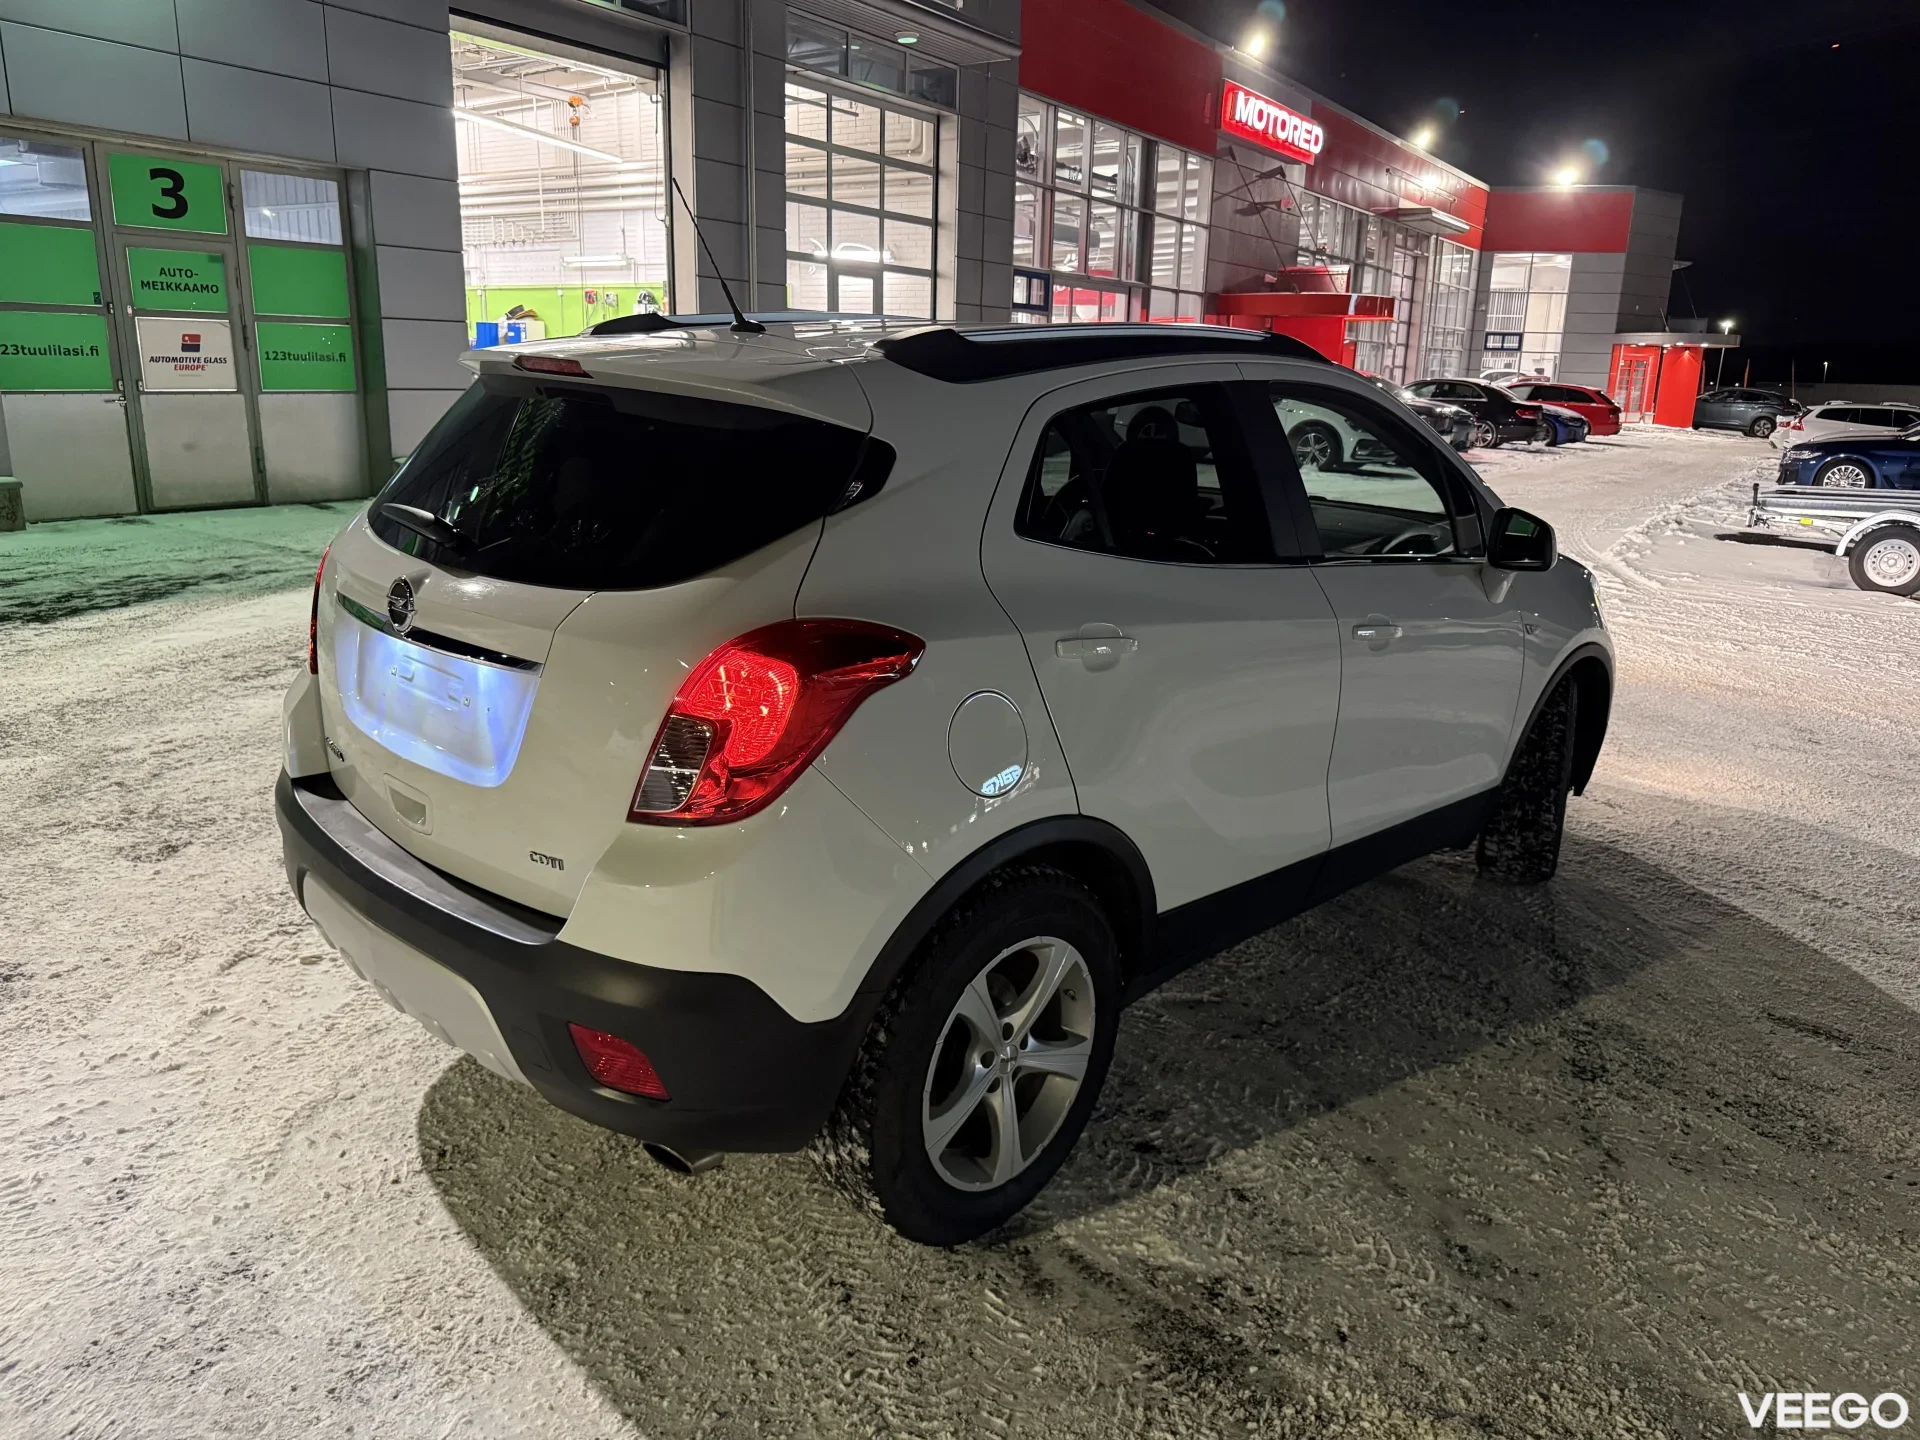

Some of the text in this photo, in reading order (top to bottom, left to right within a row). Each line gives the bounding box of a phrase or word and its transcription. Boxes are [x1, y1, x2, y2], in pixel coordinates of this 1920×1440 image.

[1234, 91, 1324, 154] MOTORED
[149, 167, 189, 219] 3
[159, 267, 199, 279] AUTO-
[140, 280, 219, 294] MEIKKAAMO
[149, 356, 228, 364] AUTOMOTIVE GLASS
[264, 350, 347, 363] 123tuulilasi.fi
